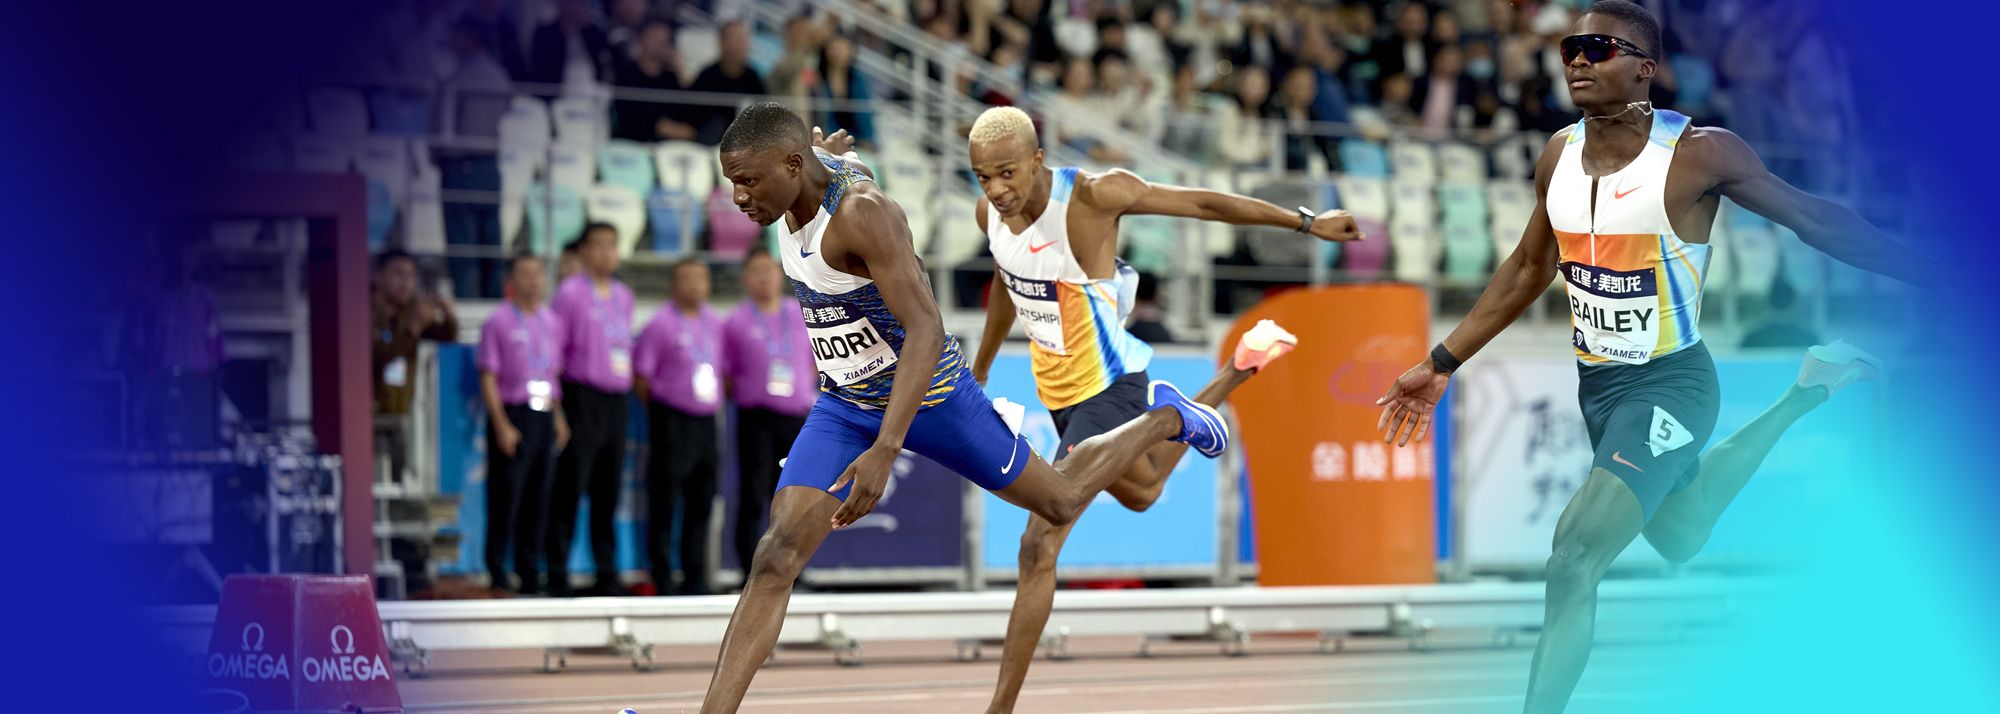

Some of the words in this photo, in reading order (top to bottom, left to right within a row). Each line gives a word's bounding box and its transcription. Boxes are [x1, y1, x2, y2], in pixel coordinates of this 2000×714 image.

[1571, 265, 1642, 293] 红星·美凯龙
[1019, 307, 1061, 326] ATSHIPI
[1571, 294, 1654, 333] BAILEY
[1600, 345, 1648, 360] XIAMEN
[843, 356, 884, 381] XIAMEN
[1657, 418, 1674, 441] 5
[208, 653, 290, 680] OMEGA
[303, 654, 390, 682] OMEGA
